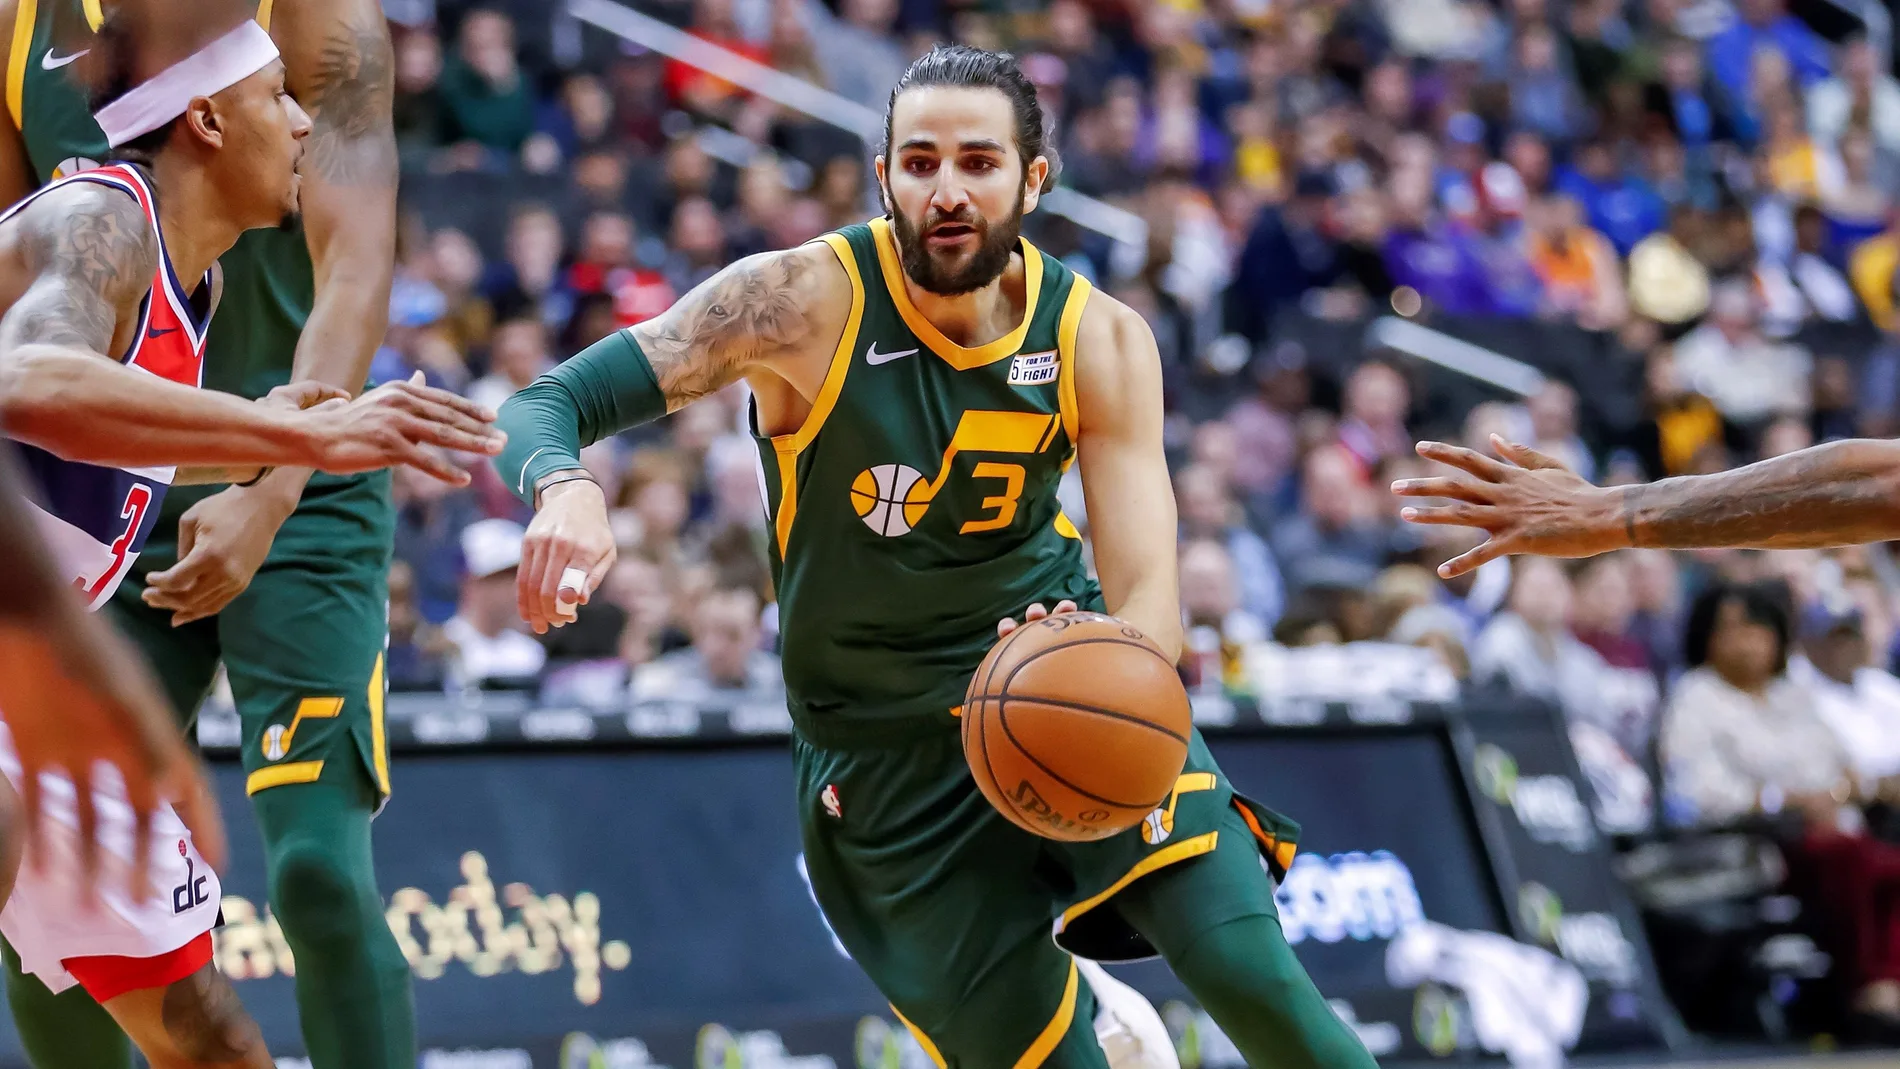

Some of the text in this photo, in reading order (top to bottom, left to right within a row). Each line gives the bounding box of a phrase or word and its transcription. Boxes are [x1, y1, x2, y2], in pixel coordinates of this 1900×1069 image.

[1011, 359, 1020, 381] 5
[1023, 366, 1055, 381] FIGHT
[1025, 355, 1053, 365] FOR THE
[959, 462, 1027, 535] 3
[72, 482, 153, 613] 3
[173, 857, 210, 914] dc
